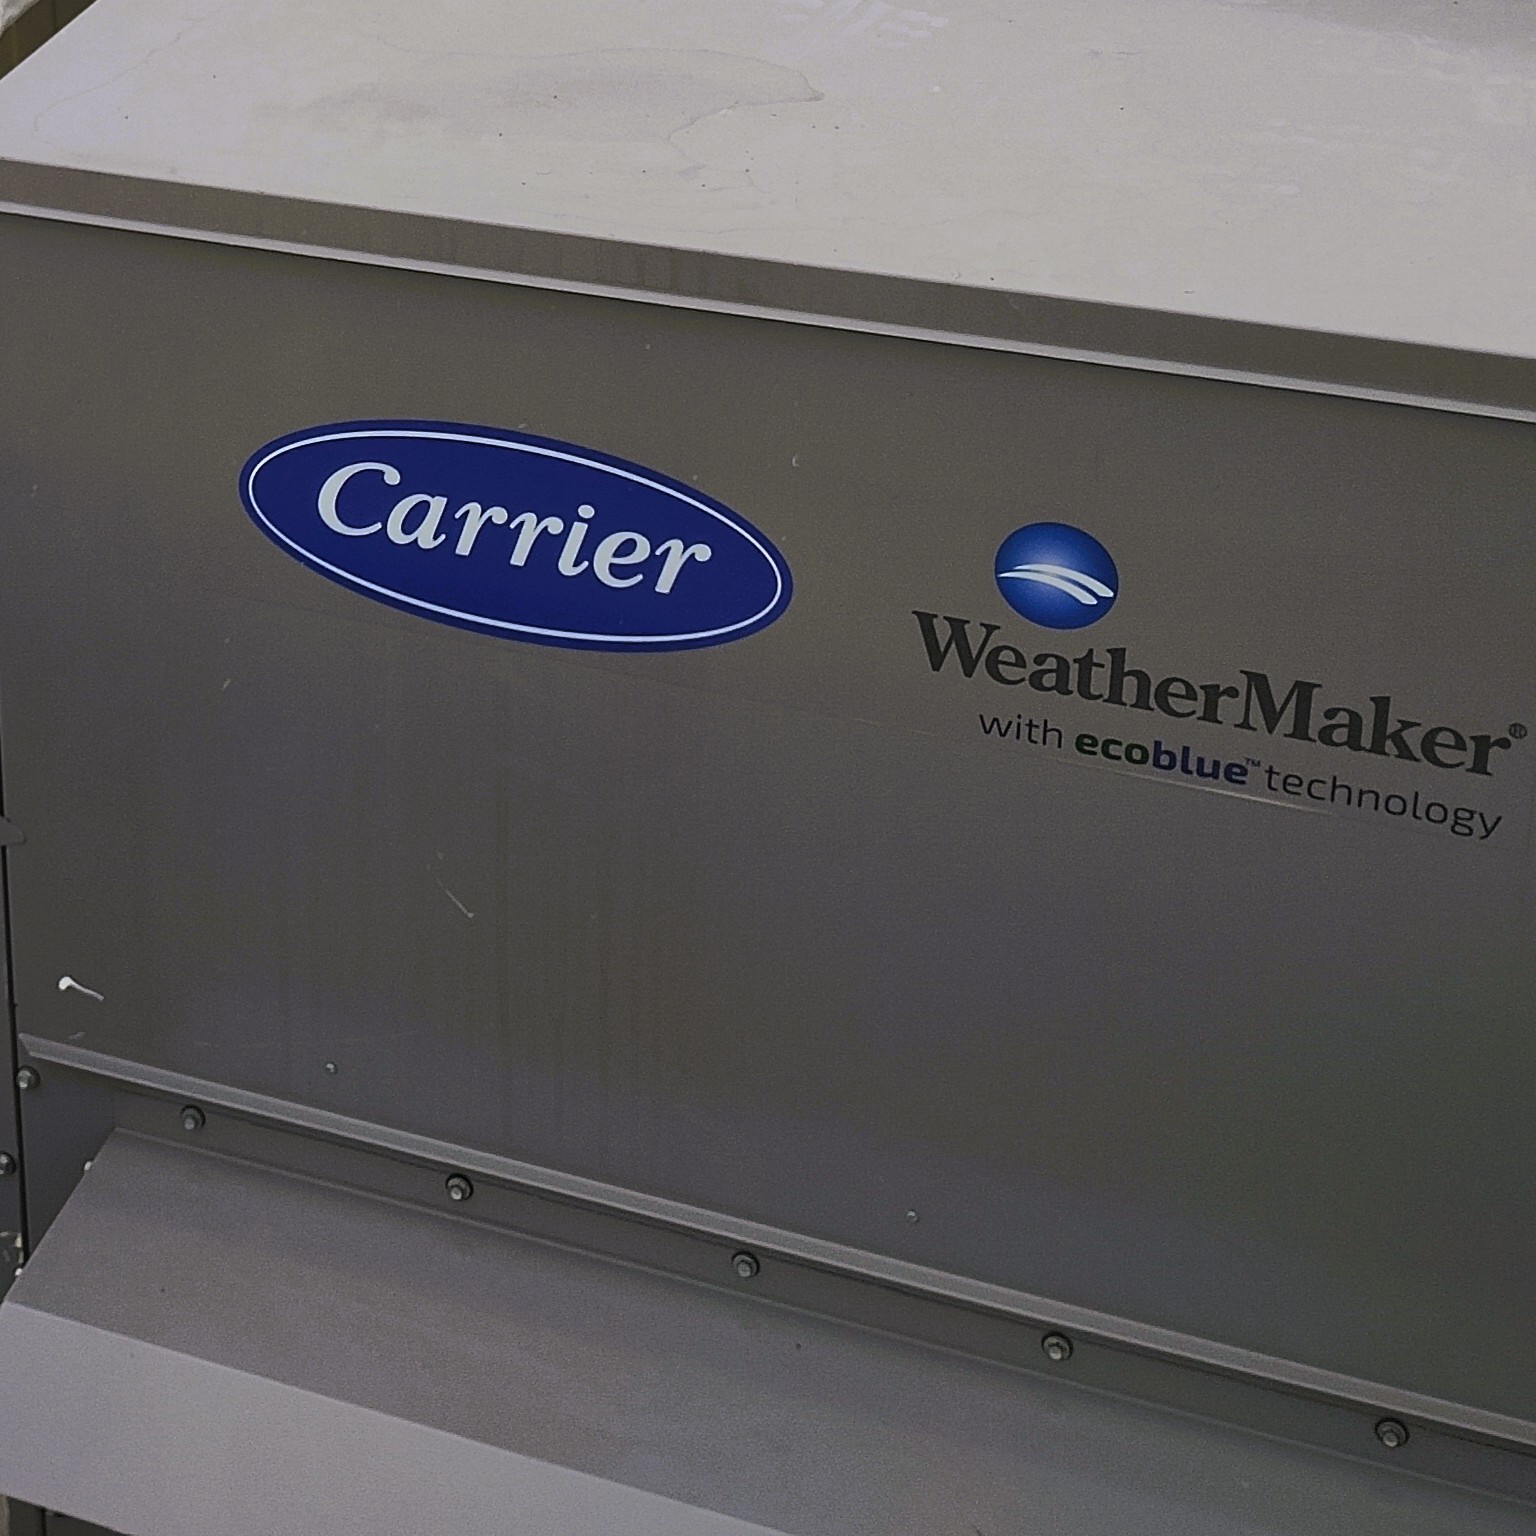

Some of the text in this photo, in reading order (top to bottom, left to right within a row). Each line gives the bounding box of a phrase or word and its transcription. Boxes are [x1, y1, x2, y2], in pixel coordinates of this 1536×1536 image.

[317, 462, 712, 594] Carrier
[978, 712, 1063, 750] with
[1264, 764, 1503, 840] technology
